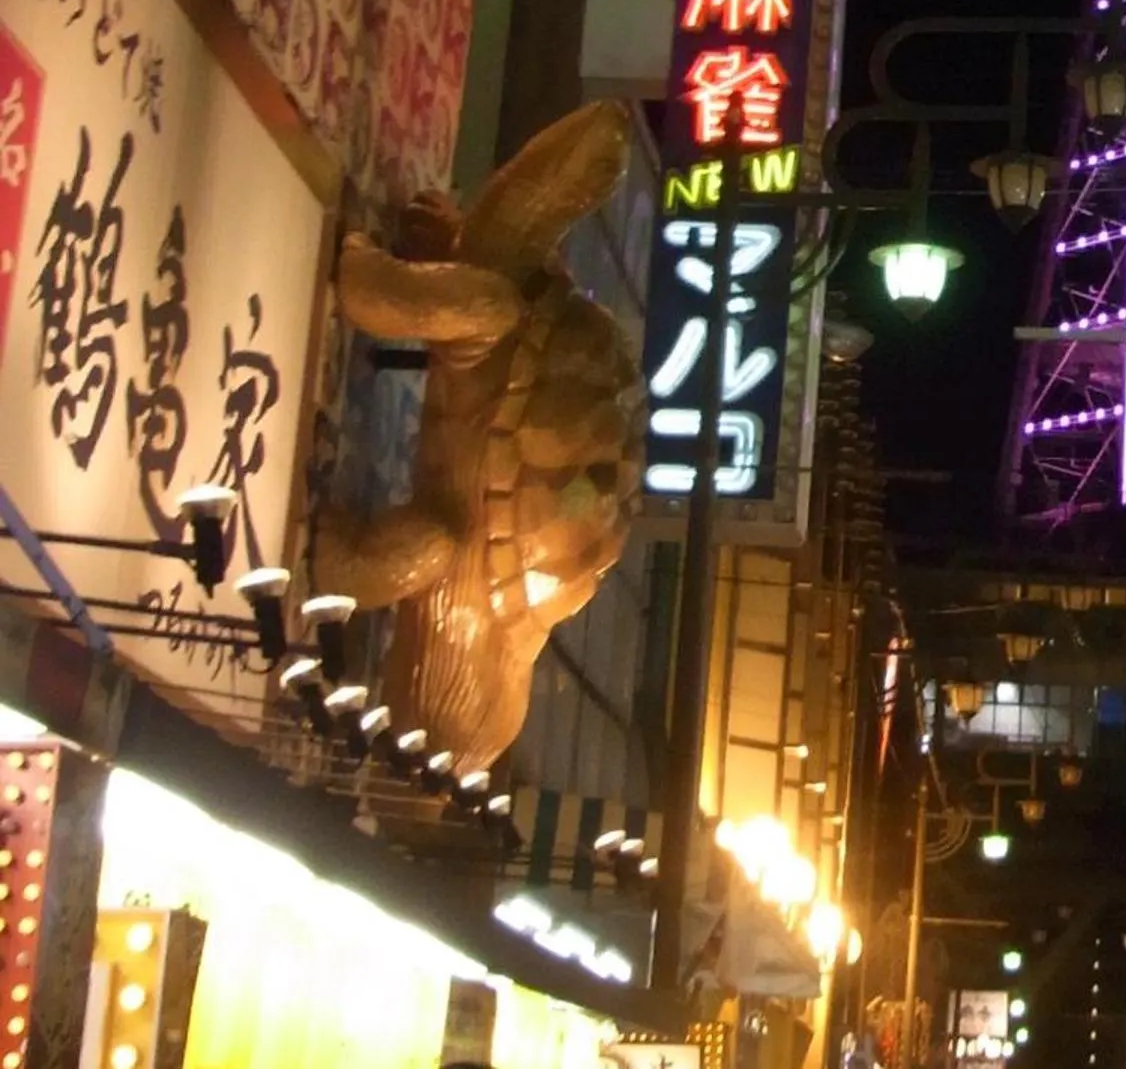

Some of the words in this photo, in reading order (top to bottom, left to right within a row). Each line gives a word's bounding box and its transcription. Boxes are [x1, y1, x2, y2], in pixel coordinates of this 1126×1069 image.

[664, 147, 798, 216] NEW
[645, 218, 784, 493] マルコ
